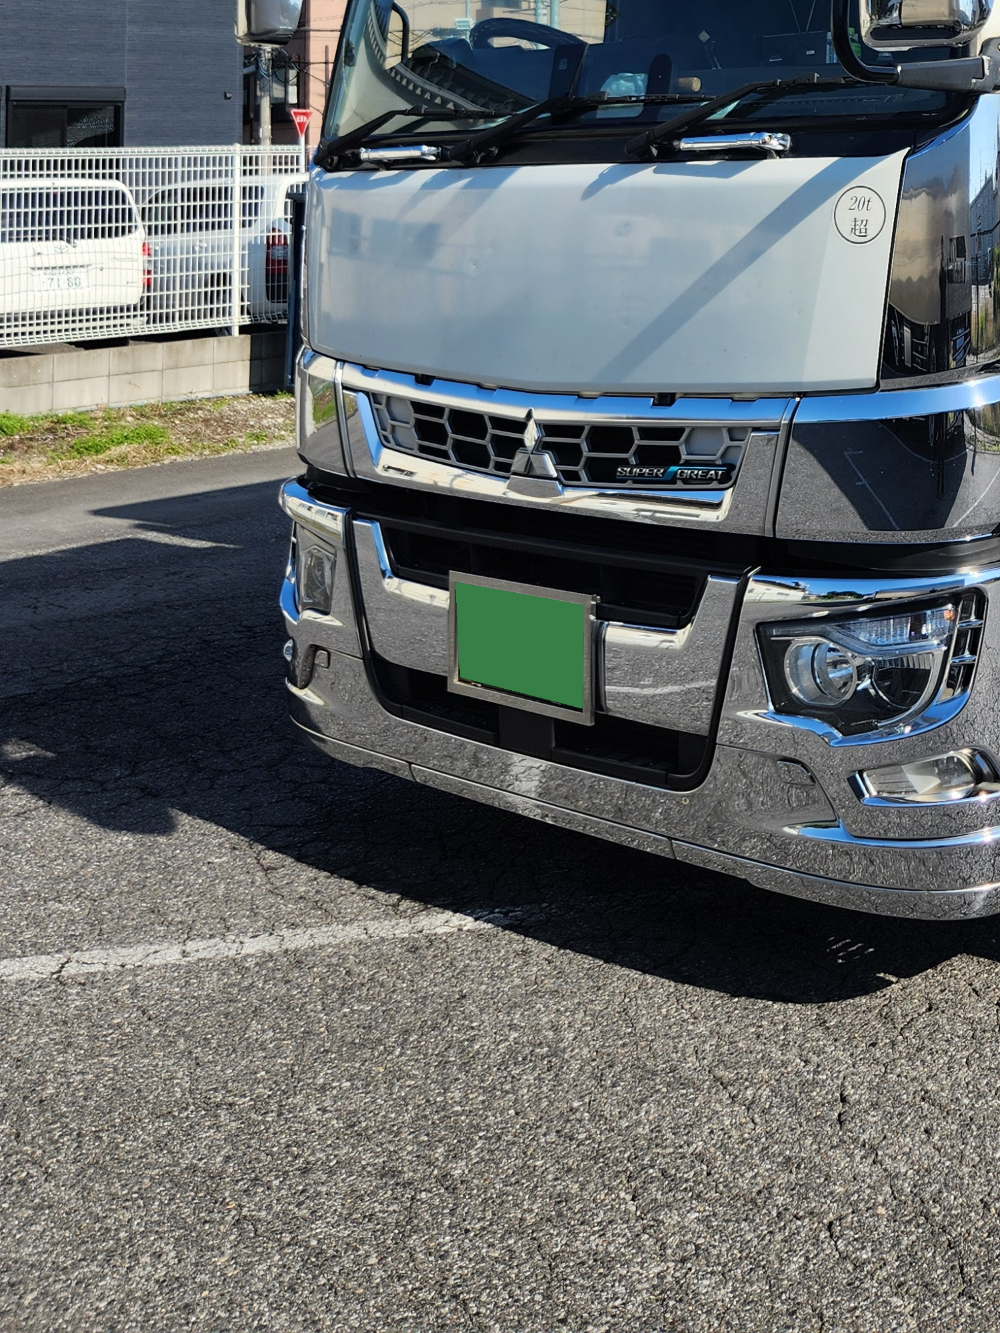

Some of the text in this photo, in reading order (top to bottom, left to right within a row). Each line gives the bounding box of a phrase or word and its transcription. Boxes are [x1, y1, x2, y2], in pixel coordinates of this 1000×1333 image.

[848, 195, 873, 212] 20t
[849, 217, 869, 238] 超
[616, 466, 726, 480] SUPER GREAT
